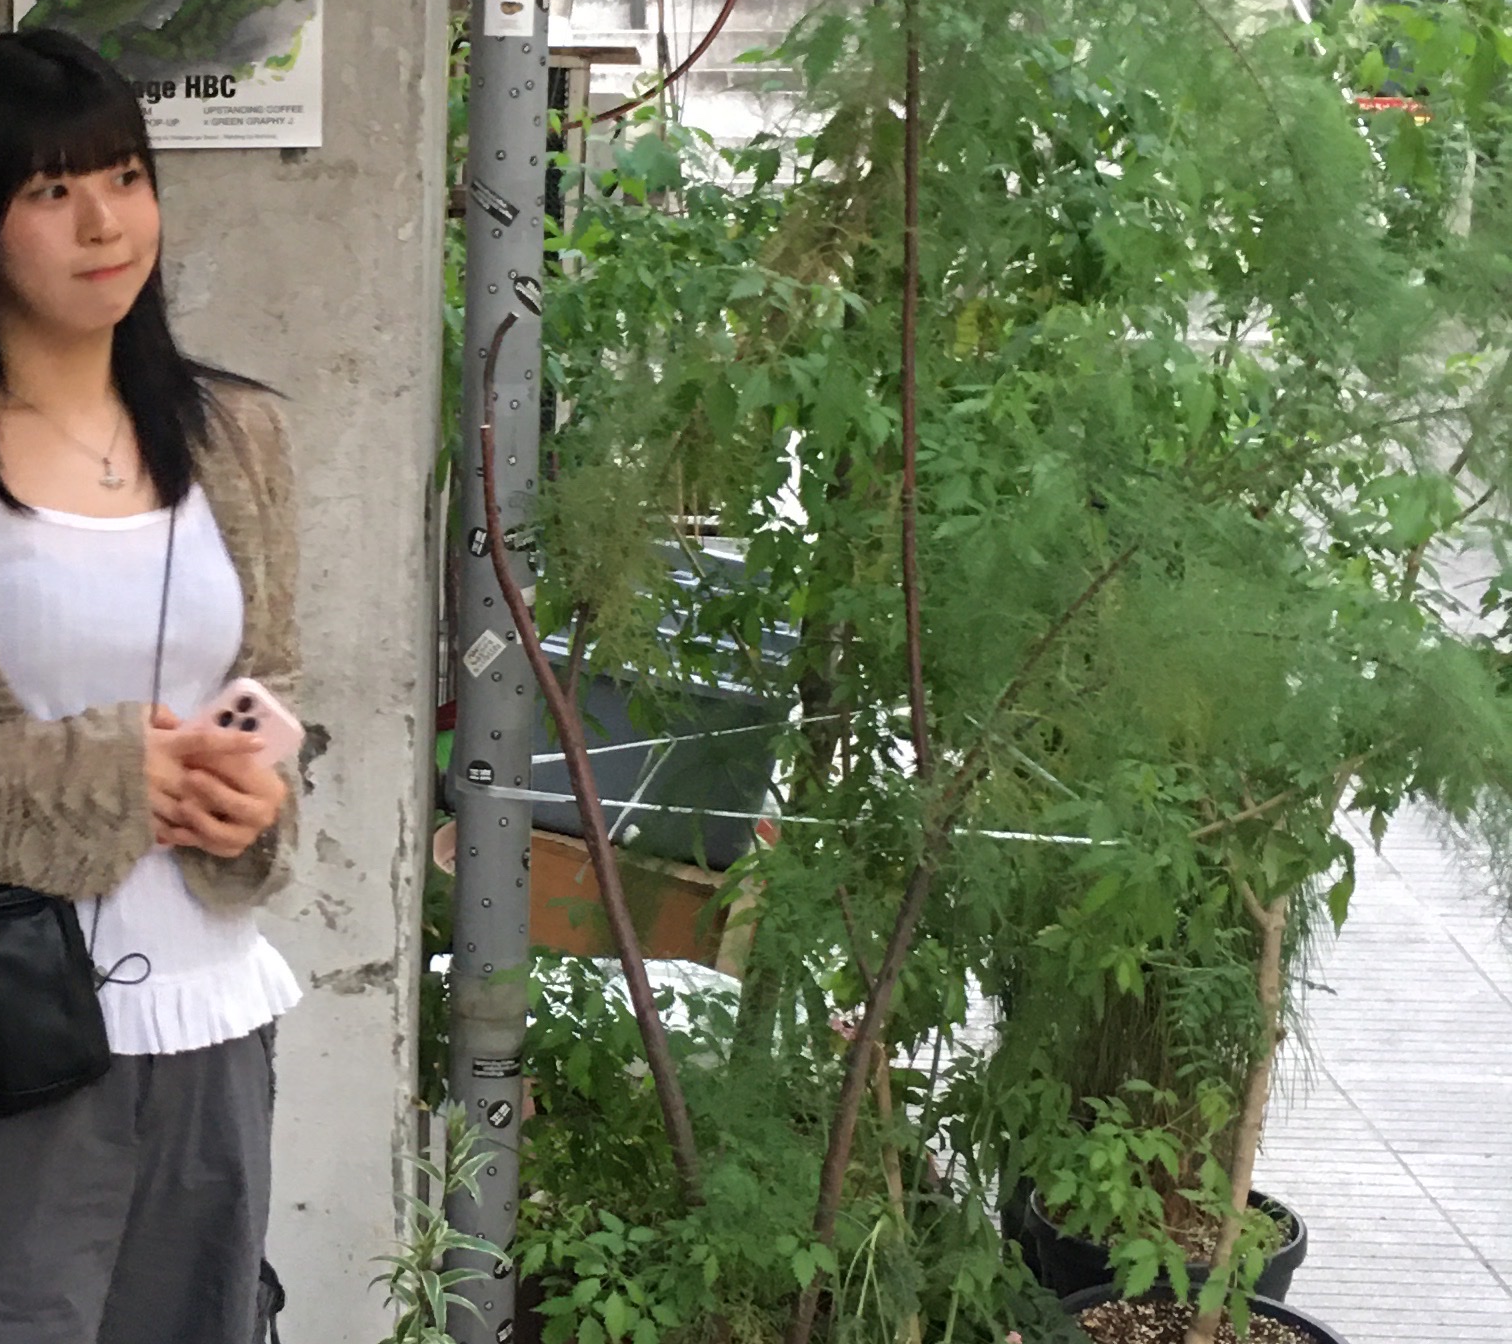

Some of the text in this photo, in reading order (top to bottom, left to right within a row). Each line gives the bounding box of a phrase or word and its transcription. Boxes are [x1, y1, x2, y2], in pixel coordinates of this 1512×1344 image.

[185, 73, 237, 98] HBC
[265, 104, 305, 114] COFFEE
[211, 117, 244, 126] GREEN
